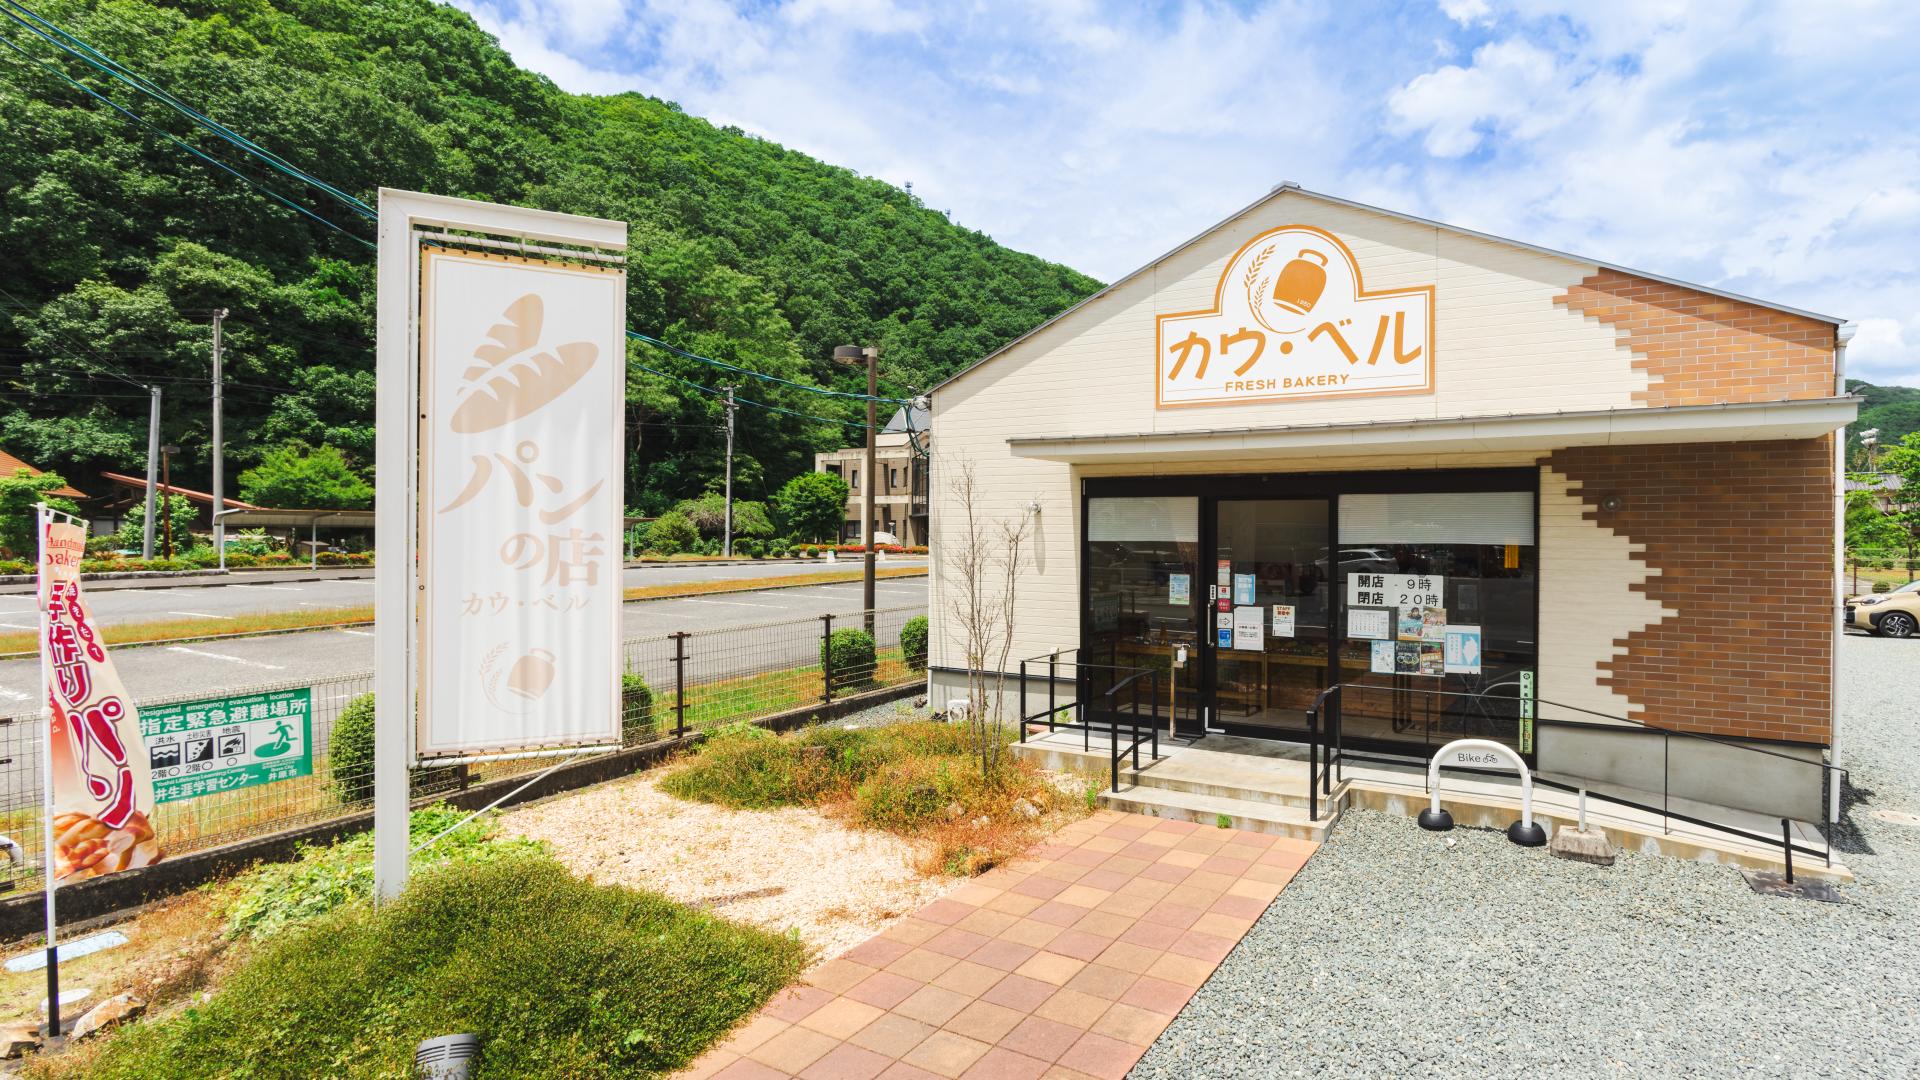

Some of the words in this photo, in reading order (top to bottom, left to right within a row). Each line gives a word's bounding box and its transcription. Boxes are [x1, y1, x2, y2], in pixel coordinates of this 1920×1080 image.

[1168, 311, 1422, 381] カウ・ベル
[1225, 379, 1276, 393] FRESH
[1283, 374, 1350, 389] BAKERY
[437, 440, 604, 525] パン
[500, 528, 605, 587] の店
[1357, 575, 1384, 588] 開店
[1407, 578, 1432, 591] 9時
[462, 591, 589, 617] カウ・ベル
[1357, 592, 1384, 605] 閉店
[1400, 594, 1439, 607] 20時
[140, 706, 181, 717] Designated
[186, 701, 225, 712] emergency
[229, 696, 265, 706] evacuation
[269, 692, 295, 700] location
[140, 698, 308, 736] 指定緊急避難場所
[155, 736, 176, 745] 洪水
[1458, 753, 1481, 763] Bike
